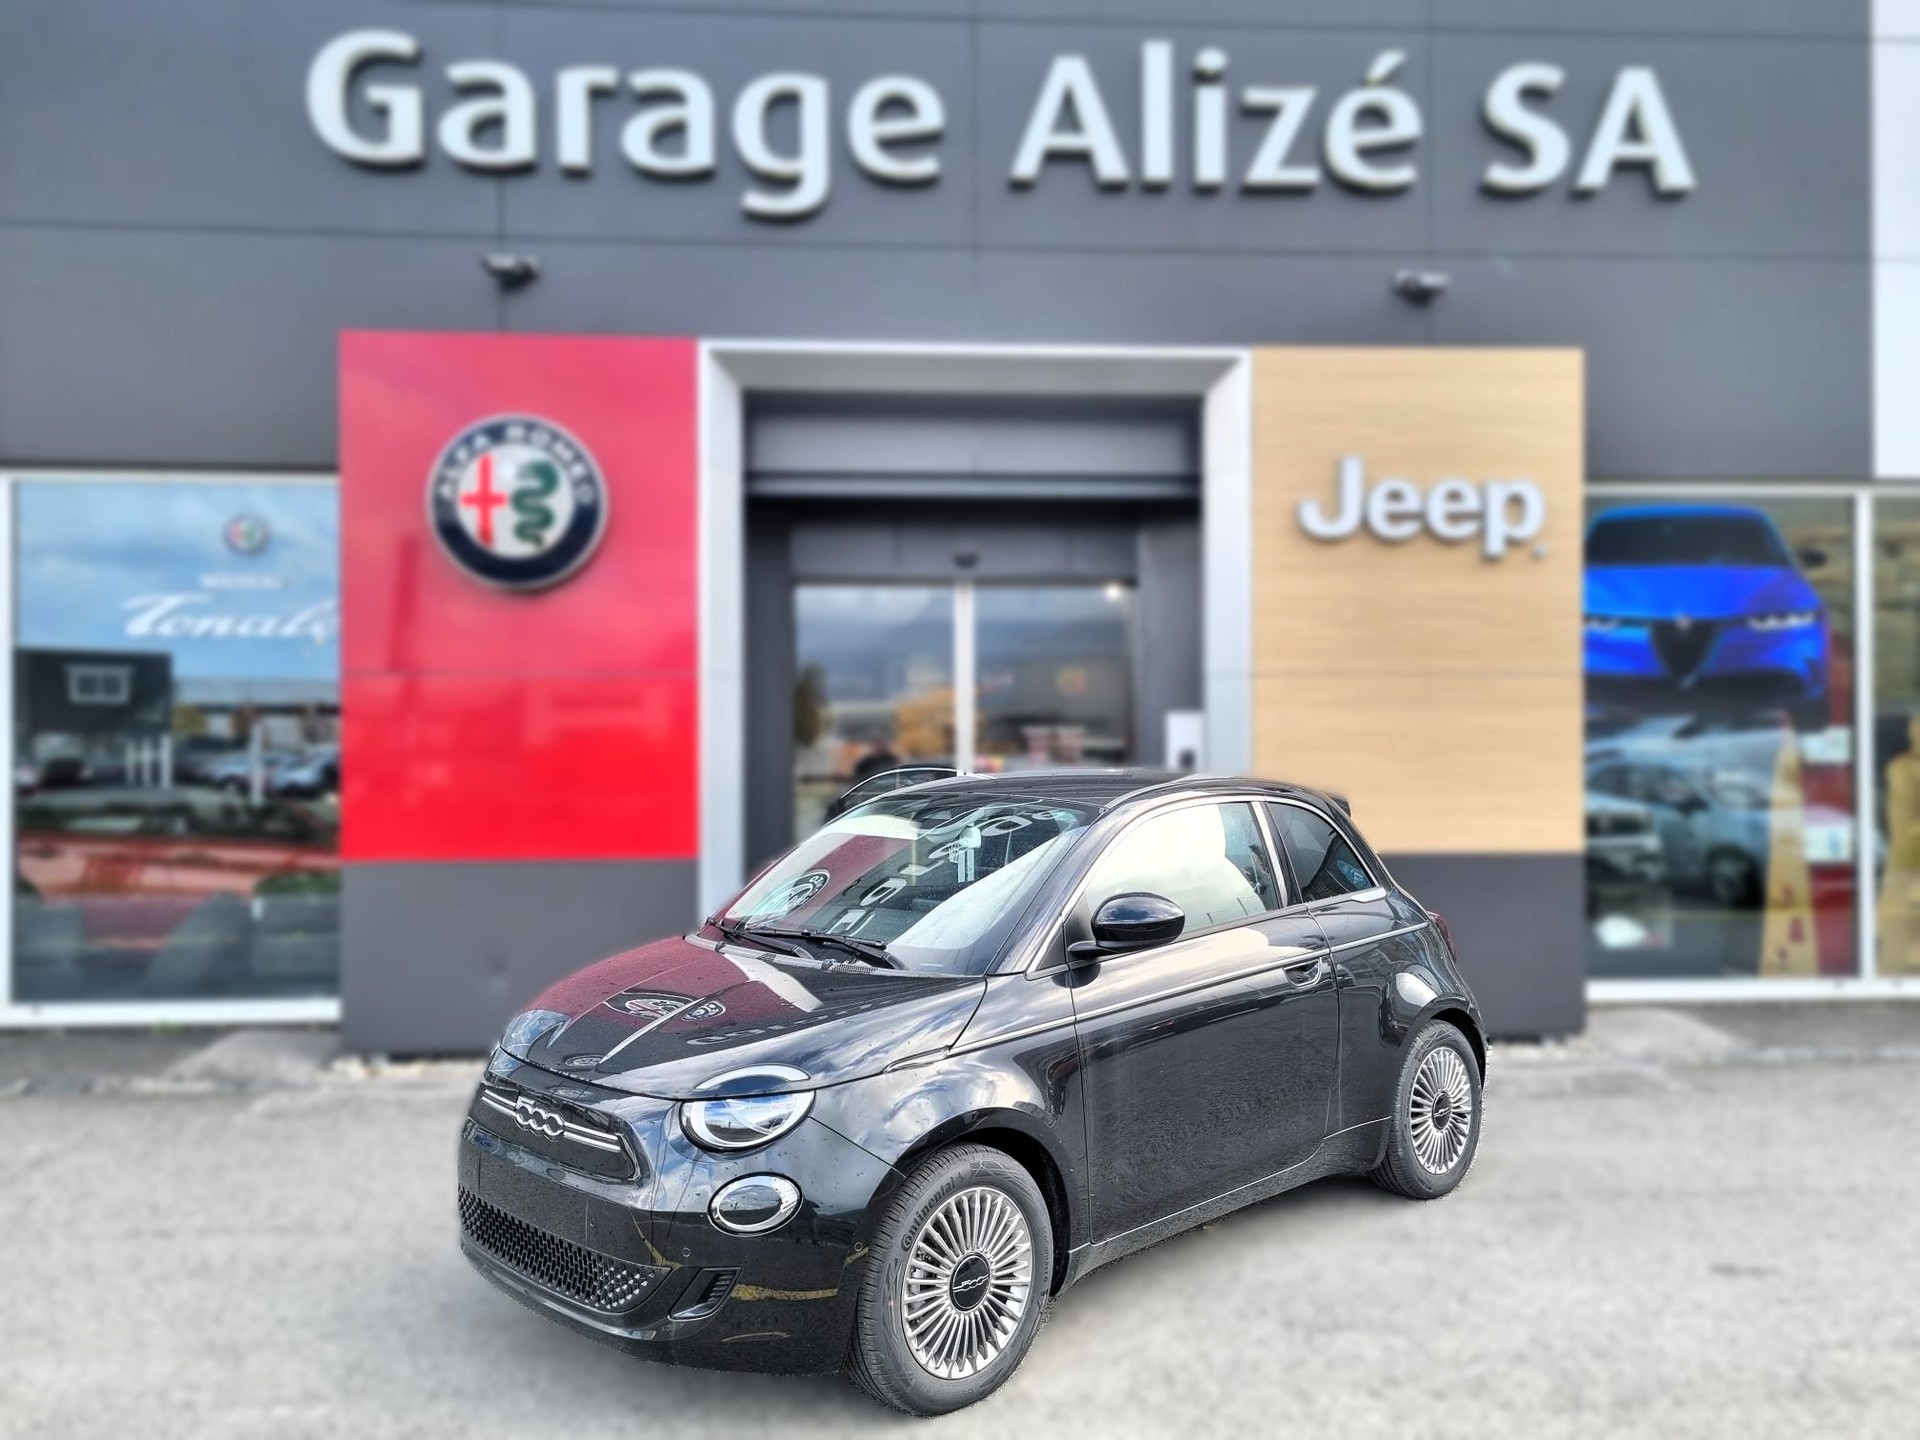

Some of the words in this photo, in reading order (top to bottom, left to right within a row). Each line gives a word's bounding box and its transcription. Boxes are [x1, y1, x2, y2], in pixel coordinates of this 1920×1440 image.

[307, 29, 946, 217] Garage
[1008, 40, 1424, 193] Alizé
[1480, 62, 1697, 197] SA
[1297, 455, 1546, 558] Jeep
[515, 1096, 563, 1136] 500
[901, 1176, 956, 1252] Continental
